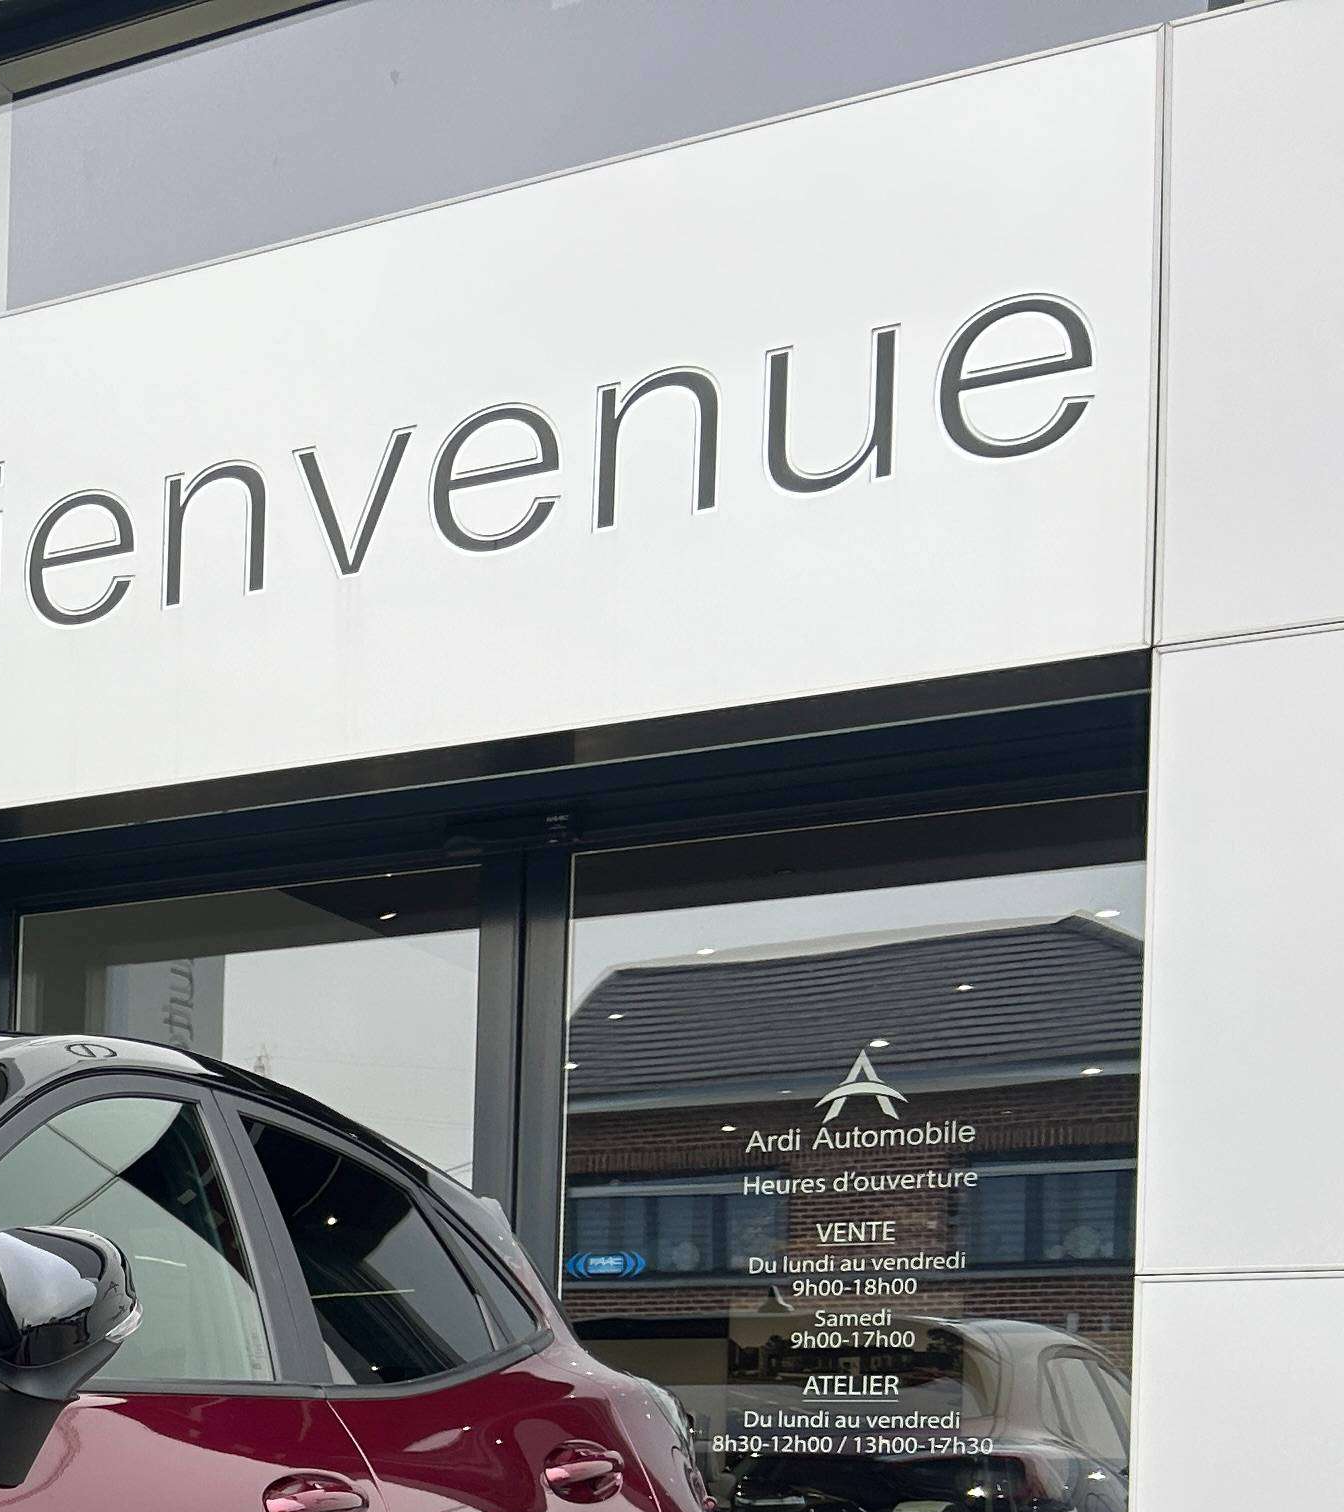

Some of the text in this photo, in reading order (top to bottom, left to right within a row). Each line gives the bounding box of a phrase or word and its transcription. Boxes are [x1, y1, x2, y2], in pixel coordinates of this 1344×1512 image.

[745, 1120, 976, 1153] Ardi Automobile
[743, 1170, 979, 1196] Heures d'ouverture
[815, 1220, 896, 1243] VENTE
[748, 1251, 966, 1275] Du lundi au vendredi
[792, 1277, 918, 1297] 9h00-18h00
[814, 1308, 892, 1328] Samedi
[790, 1330, 916, 1350] 9h00-17h00
[802, 1375, 900, 1397] ATELIER
[743, 1409, 961, 1430] Du lundi au vendredi
[712, 1434, 833, 1454] 8h30-12h00
[853, 1435, 994, 1455] 13h00-17h30
